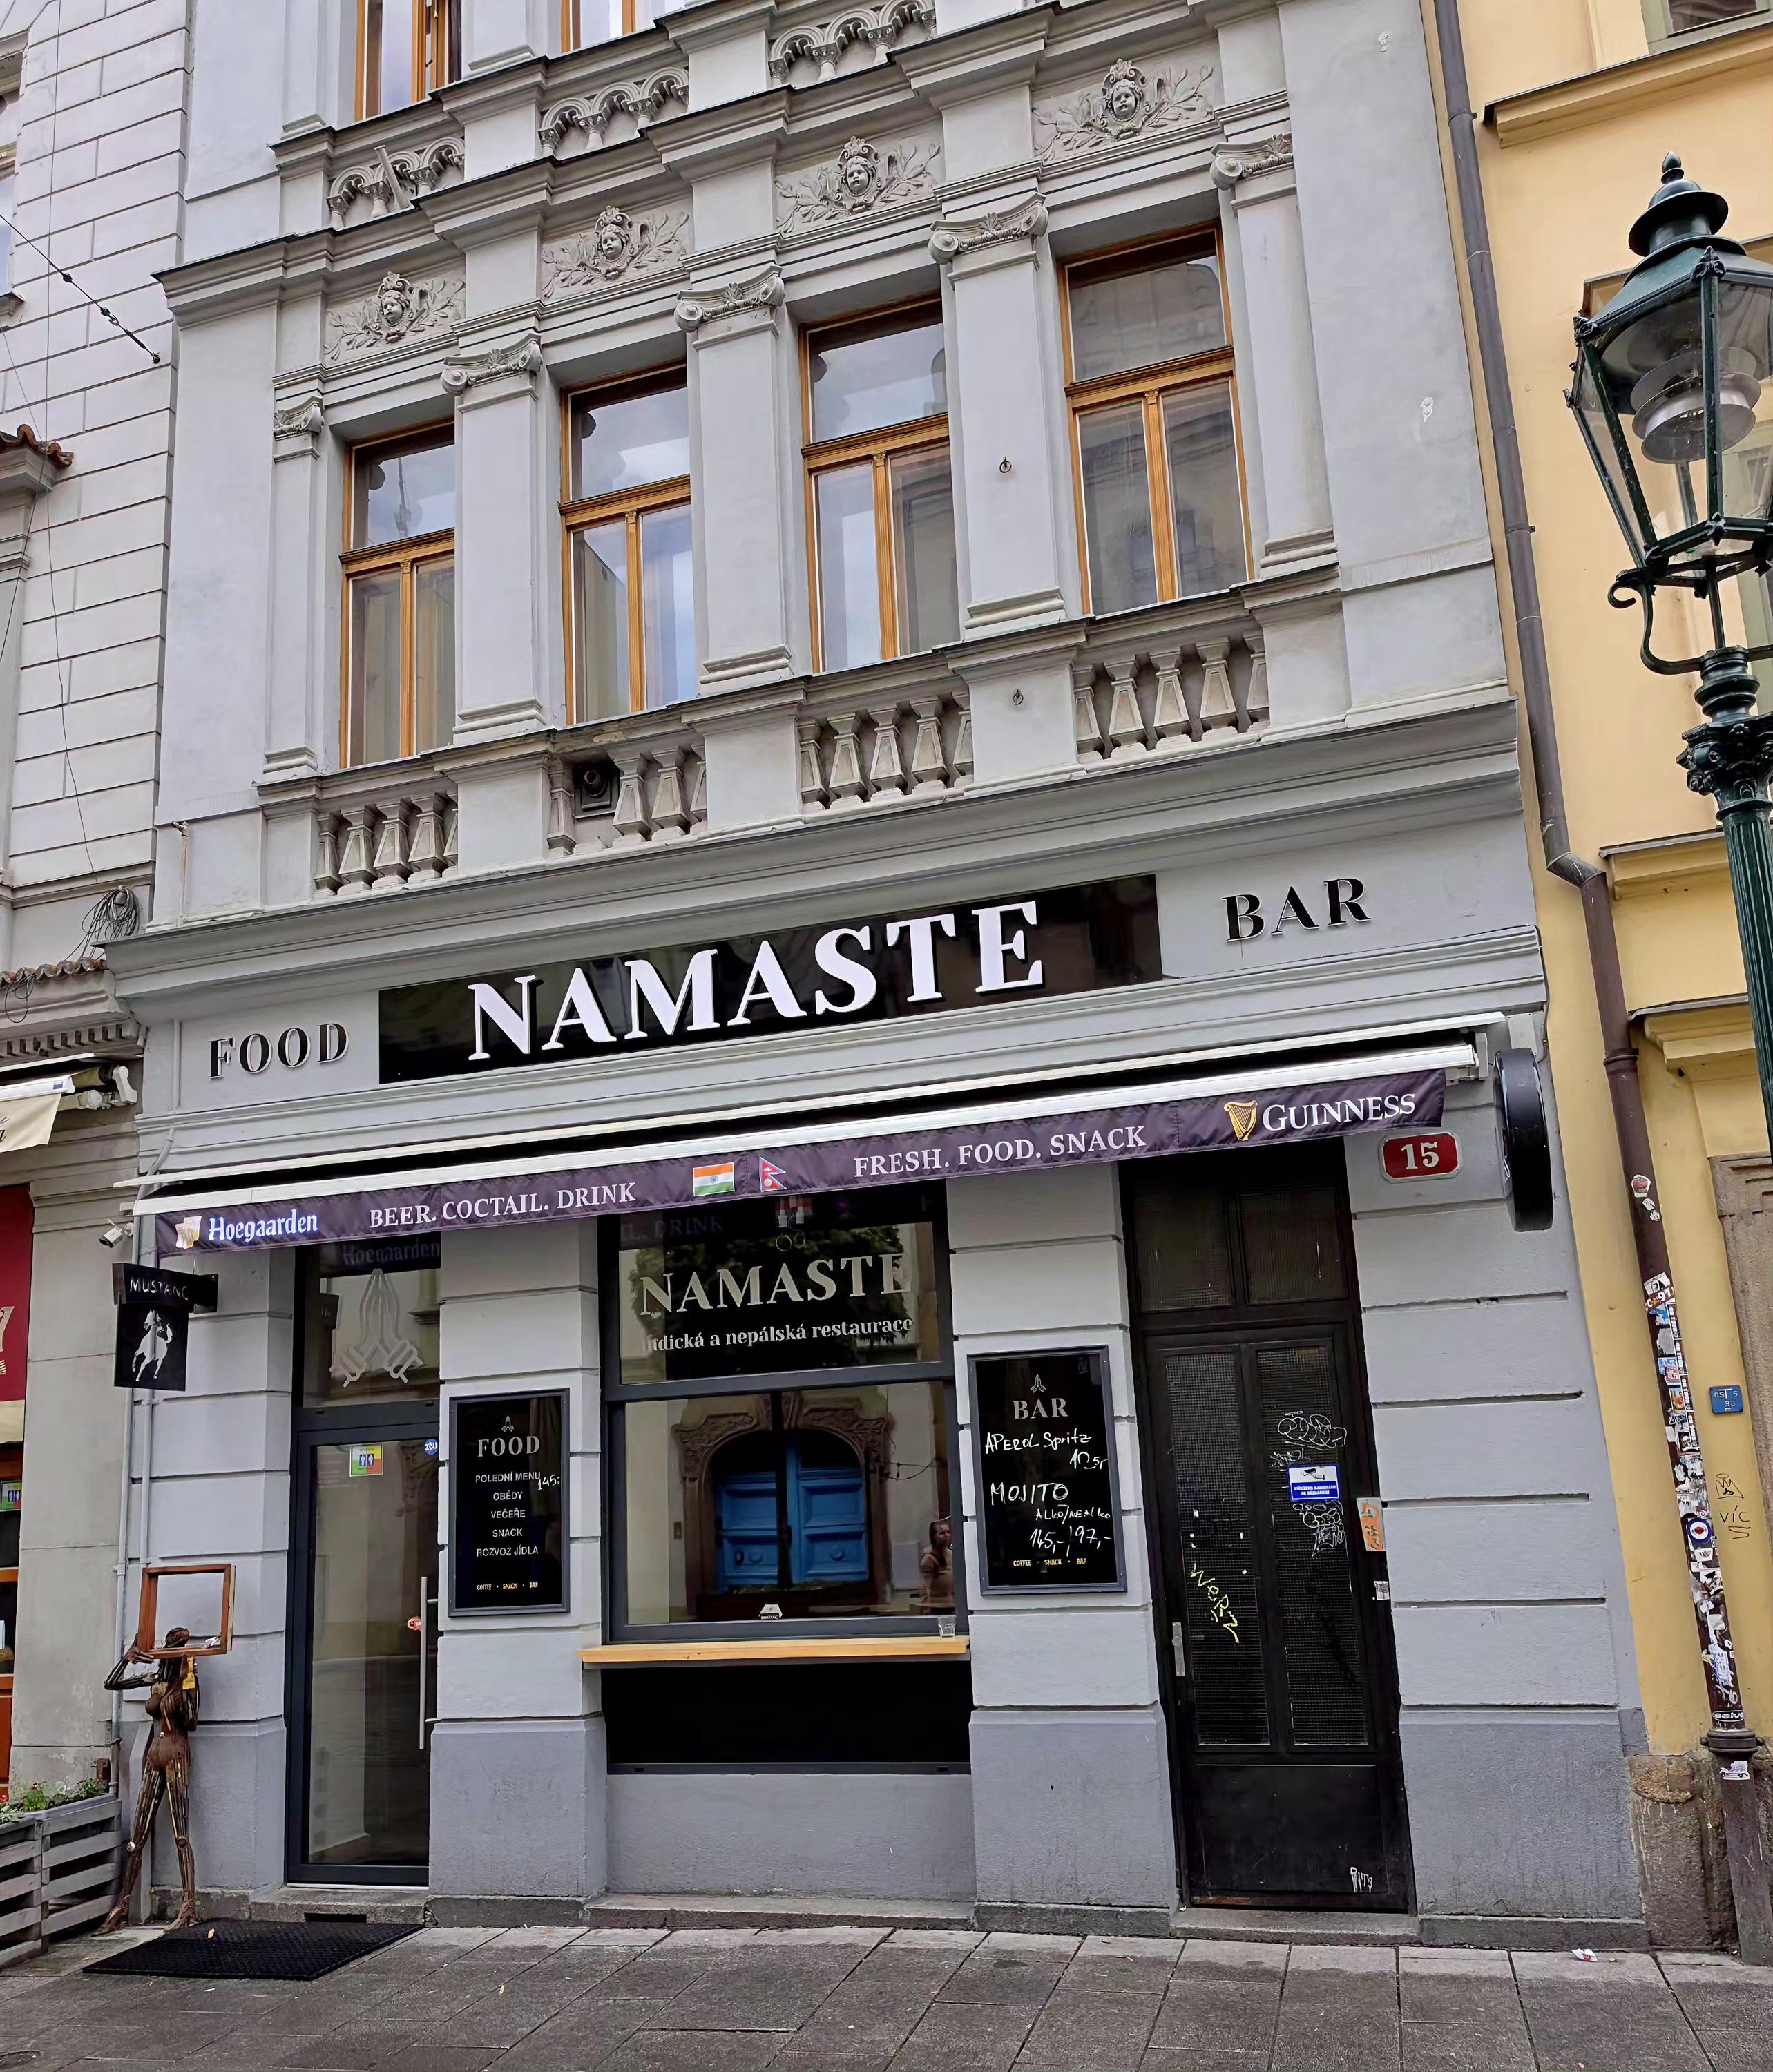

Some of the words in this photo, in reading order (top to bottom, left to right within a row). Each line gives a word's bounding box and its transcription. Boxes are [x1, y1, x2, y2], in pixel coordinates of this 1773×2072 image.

[1222, 878, 1371, 942] BAR
[468, 901, 1044, 1061] NAMASTE
[208, 1023, 349, 1079] FOOD
[1263, 1093, 1415, 1131] GUINNESS
[854, 1149, 950, 1177] FRESH.
[957, 1140, 1041, 1165] FOOD.
[1049, 1126, 1147, 1156] SNACK
[1401, 1142, 1439, 1170] 15
[369, 1205, 437, 1228] BEER.
[442, 1194, 549, 1220] COCTAIL.
[556, 1182, 636, 1209] DRINK
[208, 1209, 318, 1243] Hoegaarden
[640, 1254, 912, 1316] NAMASTE
[710, 1334, 720, 1346] a
[726, 1323, 807, 1347] nepálská
[812, 1317, 913, 1339] restaurace
[1013, 1398, 1069, 1420] BAR
[477, 1435, 540, 1457] FOOD
[475, 1471, 513, 1483] POLEDNÍ
[515, 1472, 541, 1481] MENU
[493, 1490, 523, 1501] OBĚDY
[990, 1482, 1068, 1506] MOJITO
[491, 1508, 526, 1519] VEČEŘE
[492, 1528, 523, 1537] SNACK
[477, 1548, 512, 1557] ROZVOZ
[514, 1544, 539, 1555] JÍDLA
